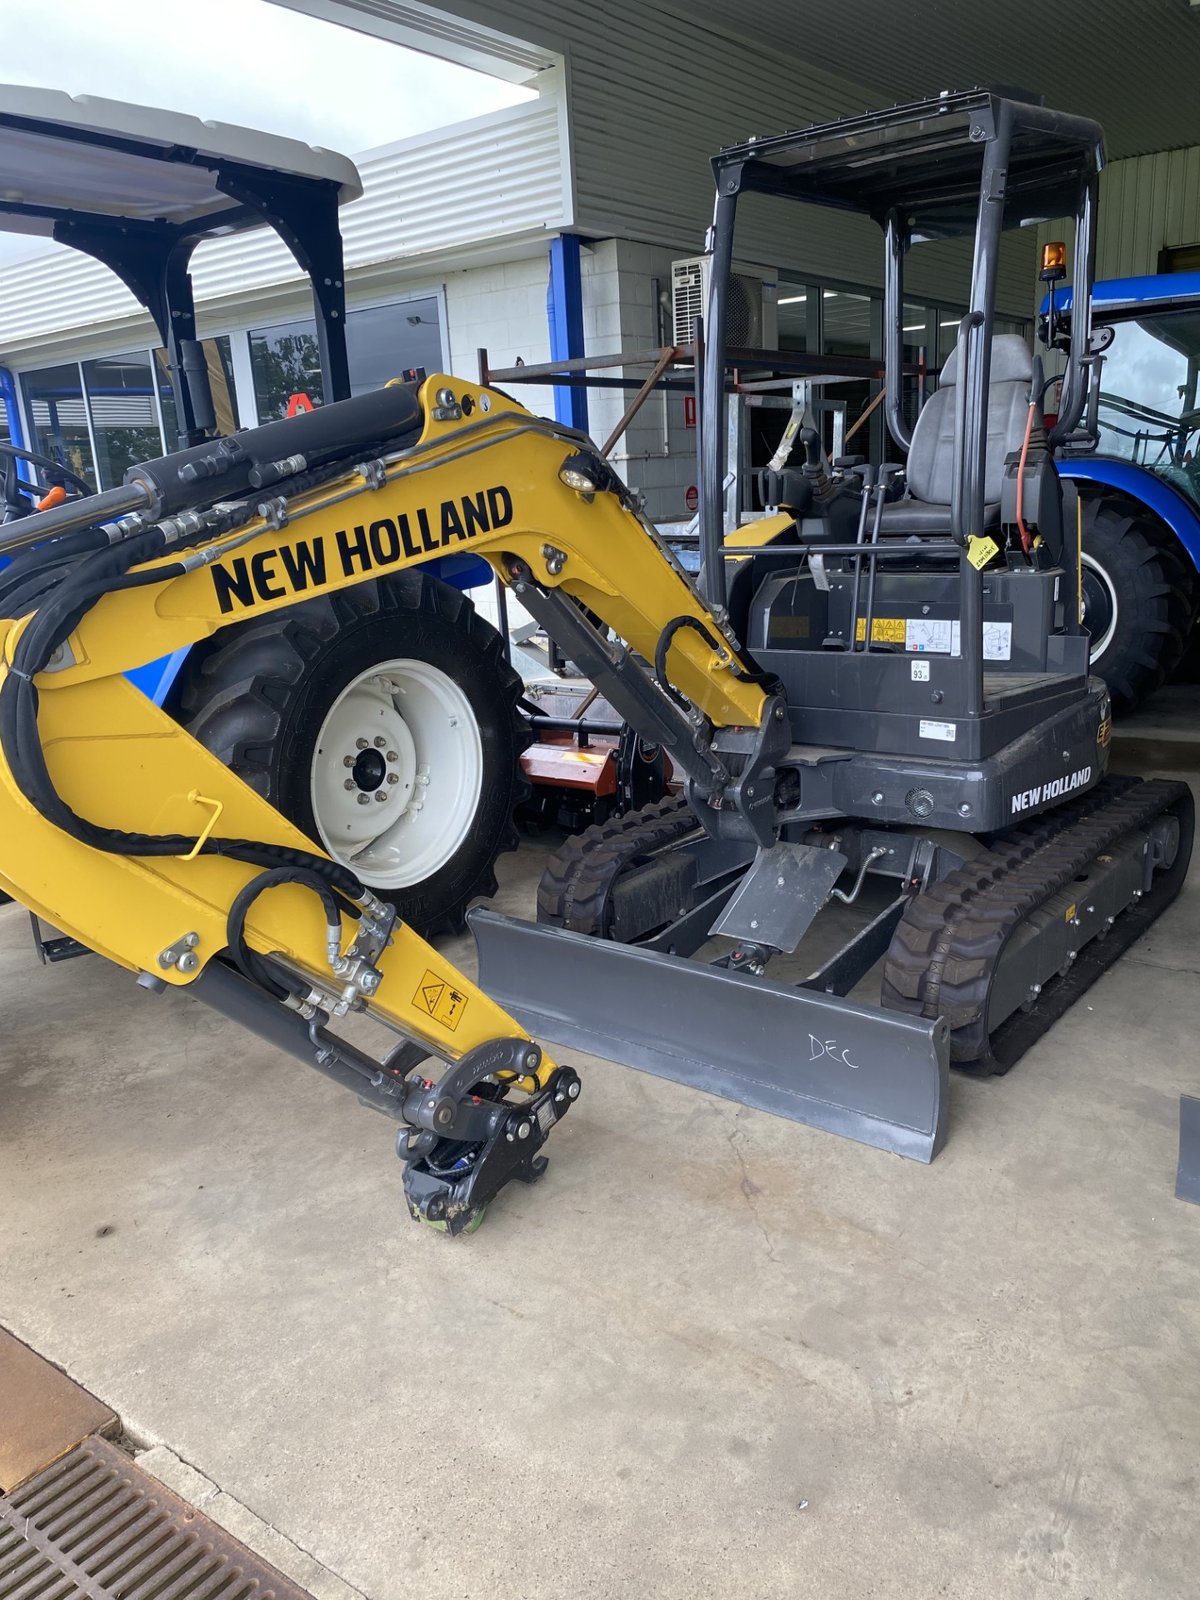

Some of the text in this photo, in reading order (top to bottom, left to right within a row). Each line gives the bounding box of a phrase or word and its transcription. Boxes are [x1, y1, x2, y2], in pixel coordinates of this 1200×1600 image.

[210, 485, 513, 614] NEW HOLLAND
[913, 669, 923, 679] 93
[1011, 766, 1091, 814] NEW HOLLAND
[808, 1033, 859, 1069] DEC
